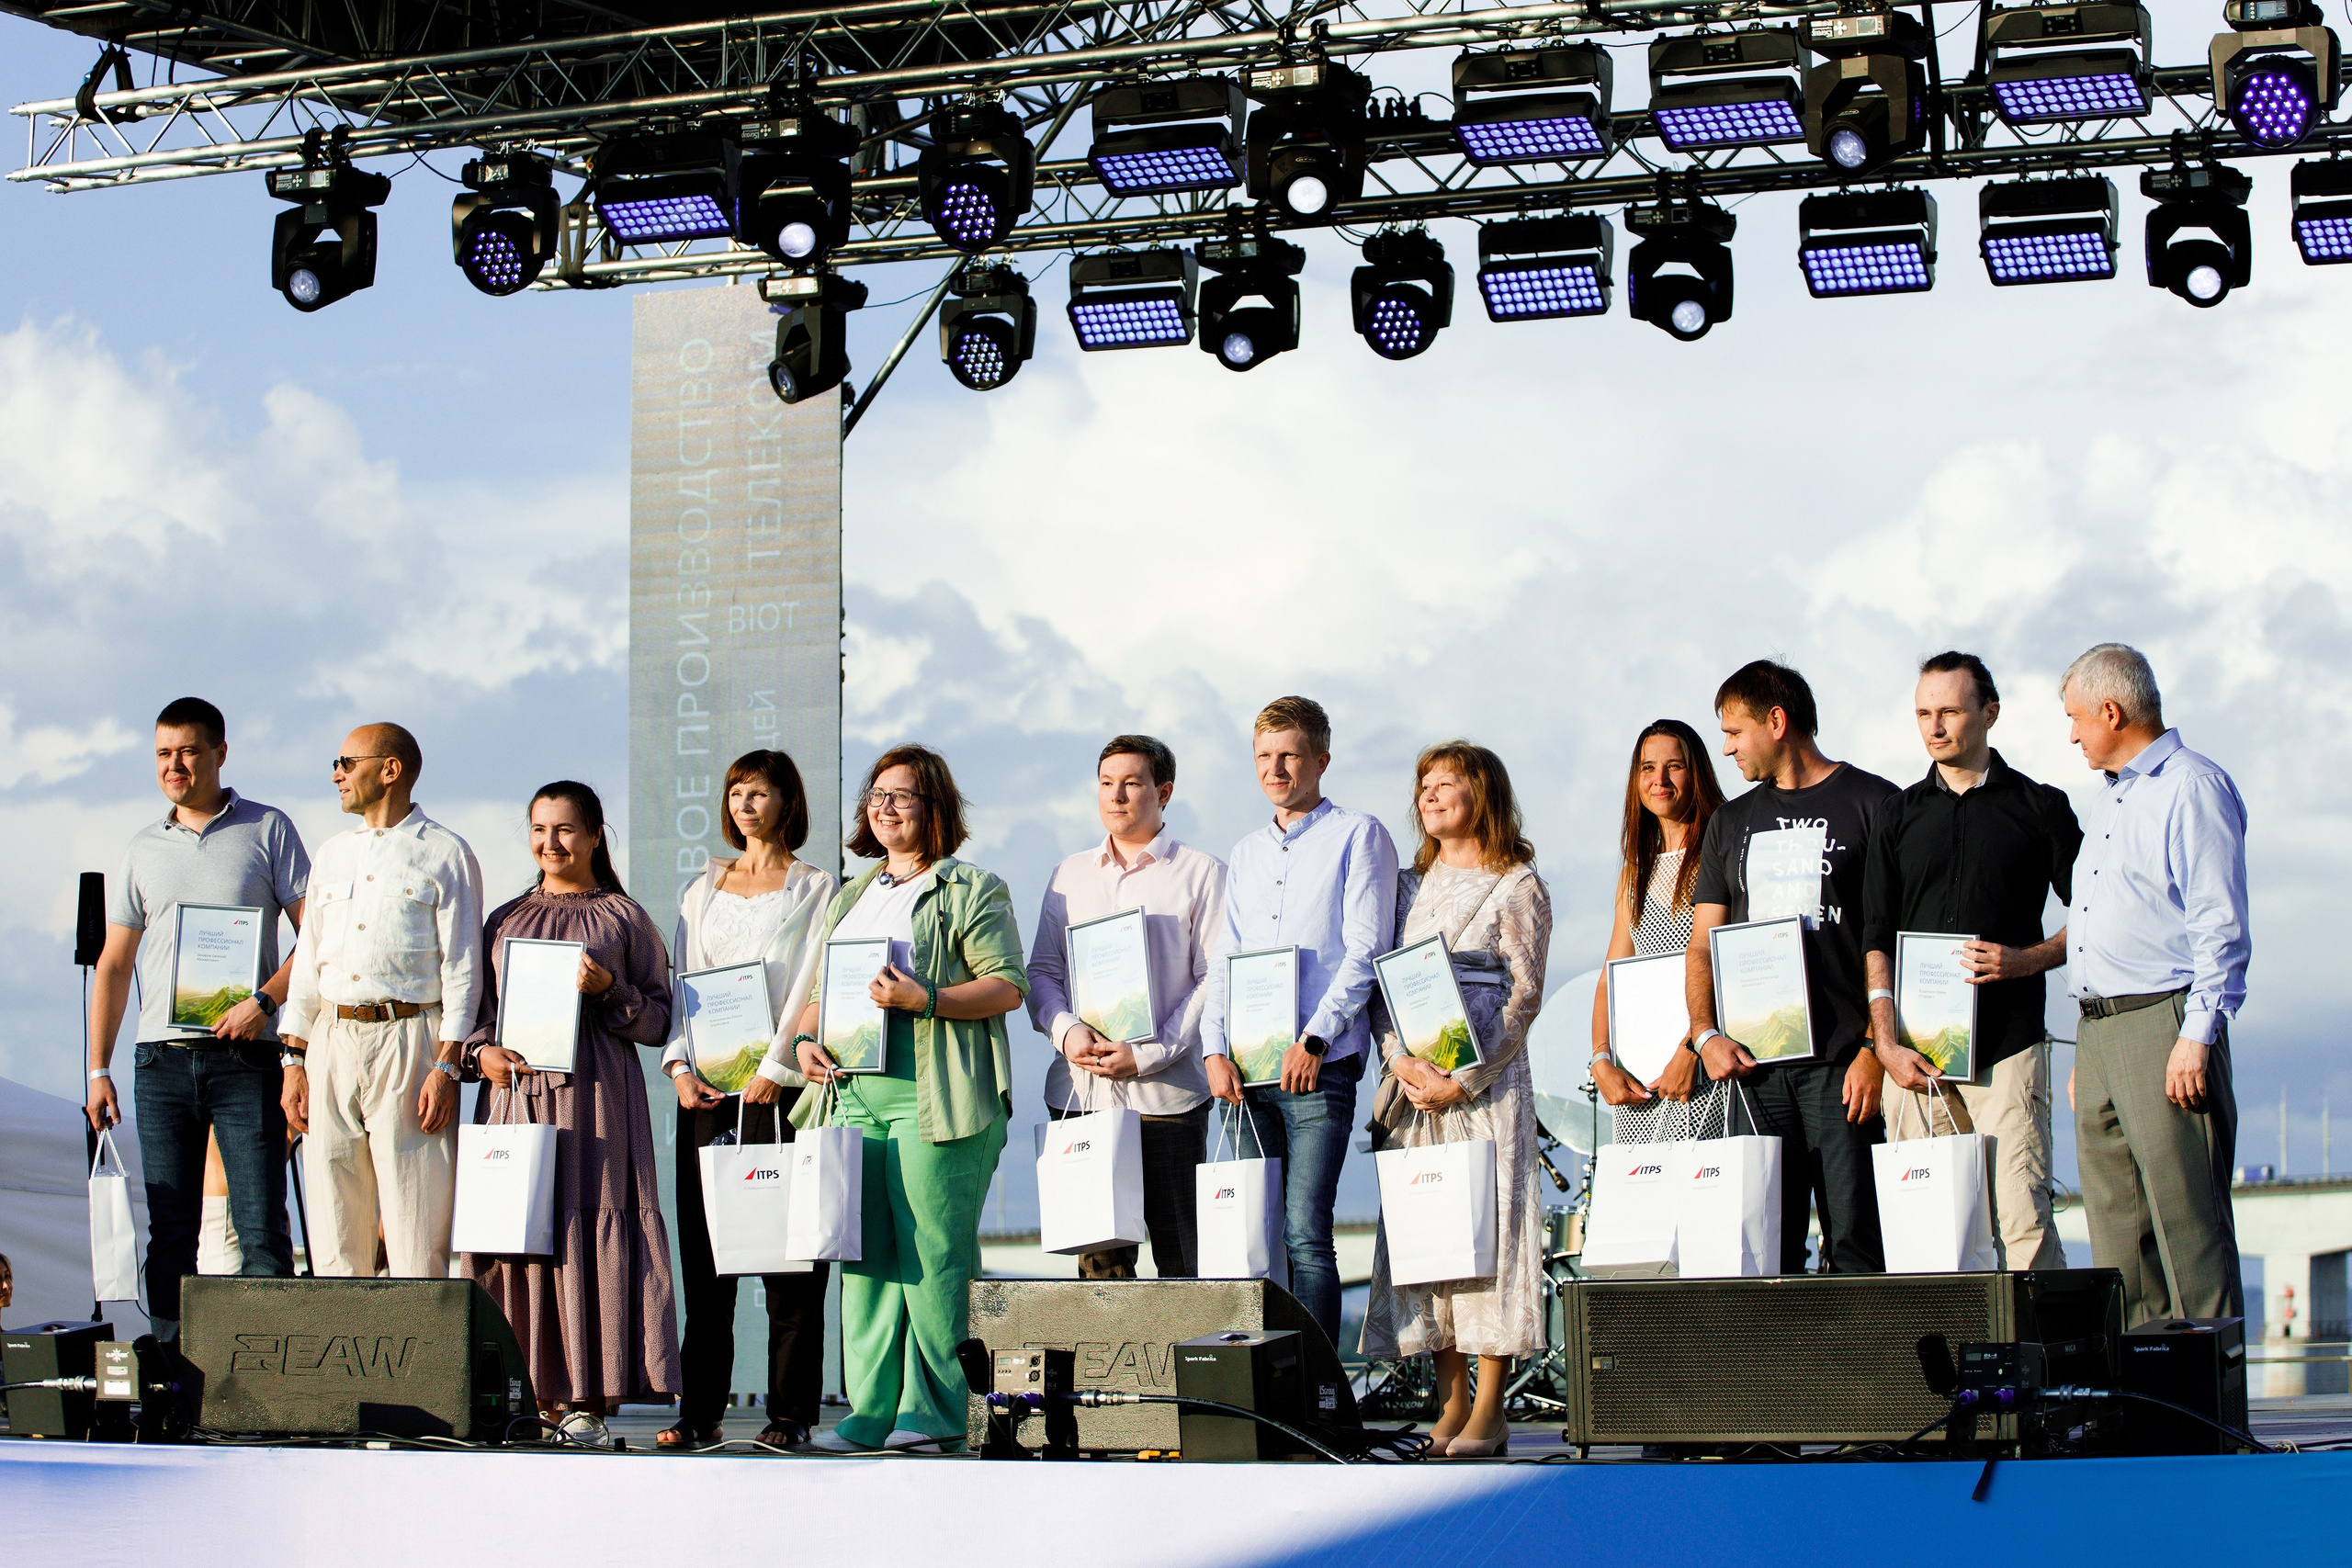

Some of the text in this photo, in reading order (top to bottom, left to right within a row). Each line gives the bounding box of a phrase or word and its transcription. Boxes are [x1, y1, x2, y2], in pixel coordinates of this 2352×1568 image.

[677, 338, 719, 755] ПРОИЗВОДСТВО
[1776, 817, 1828, 832] TWO
[198, 937, 244, 945] ПРОФЕССИОНАЛ
[1919, 970, 1961, 978] ПРОФЕССИОНАЛ
[707, 991, 731, 1001] ЛУЧШИЙ
[707, 995, 752, 1008] ПРОФЕССИОНАЛ
[708, 1004, 741, 1014] КОМПАНИИ
[1074, 1140, 1091, 1153] ITPS
[492, 1150, 510, 1159] ITPS
[757, 1169, 780, 1179] ITPS
[1640, 1166, 1662, 1175] ITPS
[1703, 1167, 1720, 1179] ITPS
[1912, 1168, 1930, 1179] ITPS
[1422, 1172, 1442, 1183] ITPS
[1222, 1189, 1235, 1199] ITPS
[281, 1335, 418, 1378] EAW
